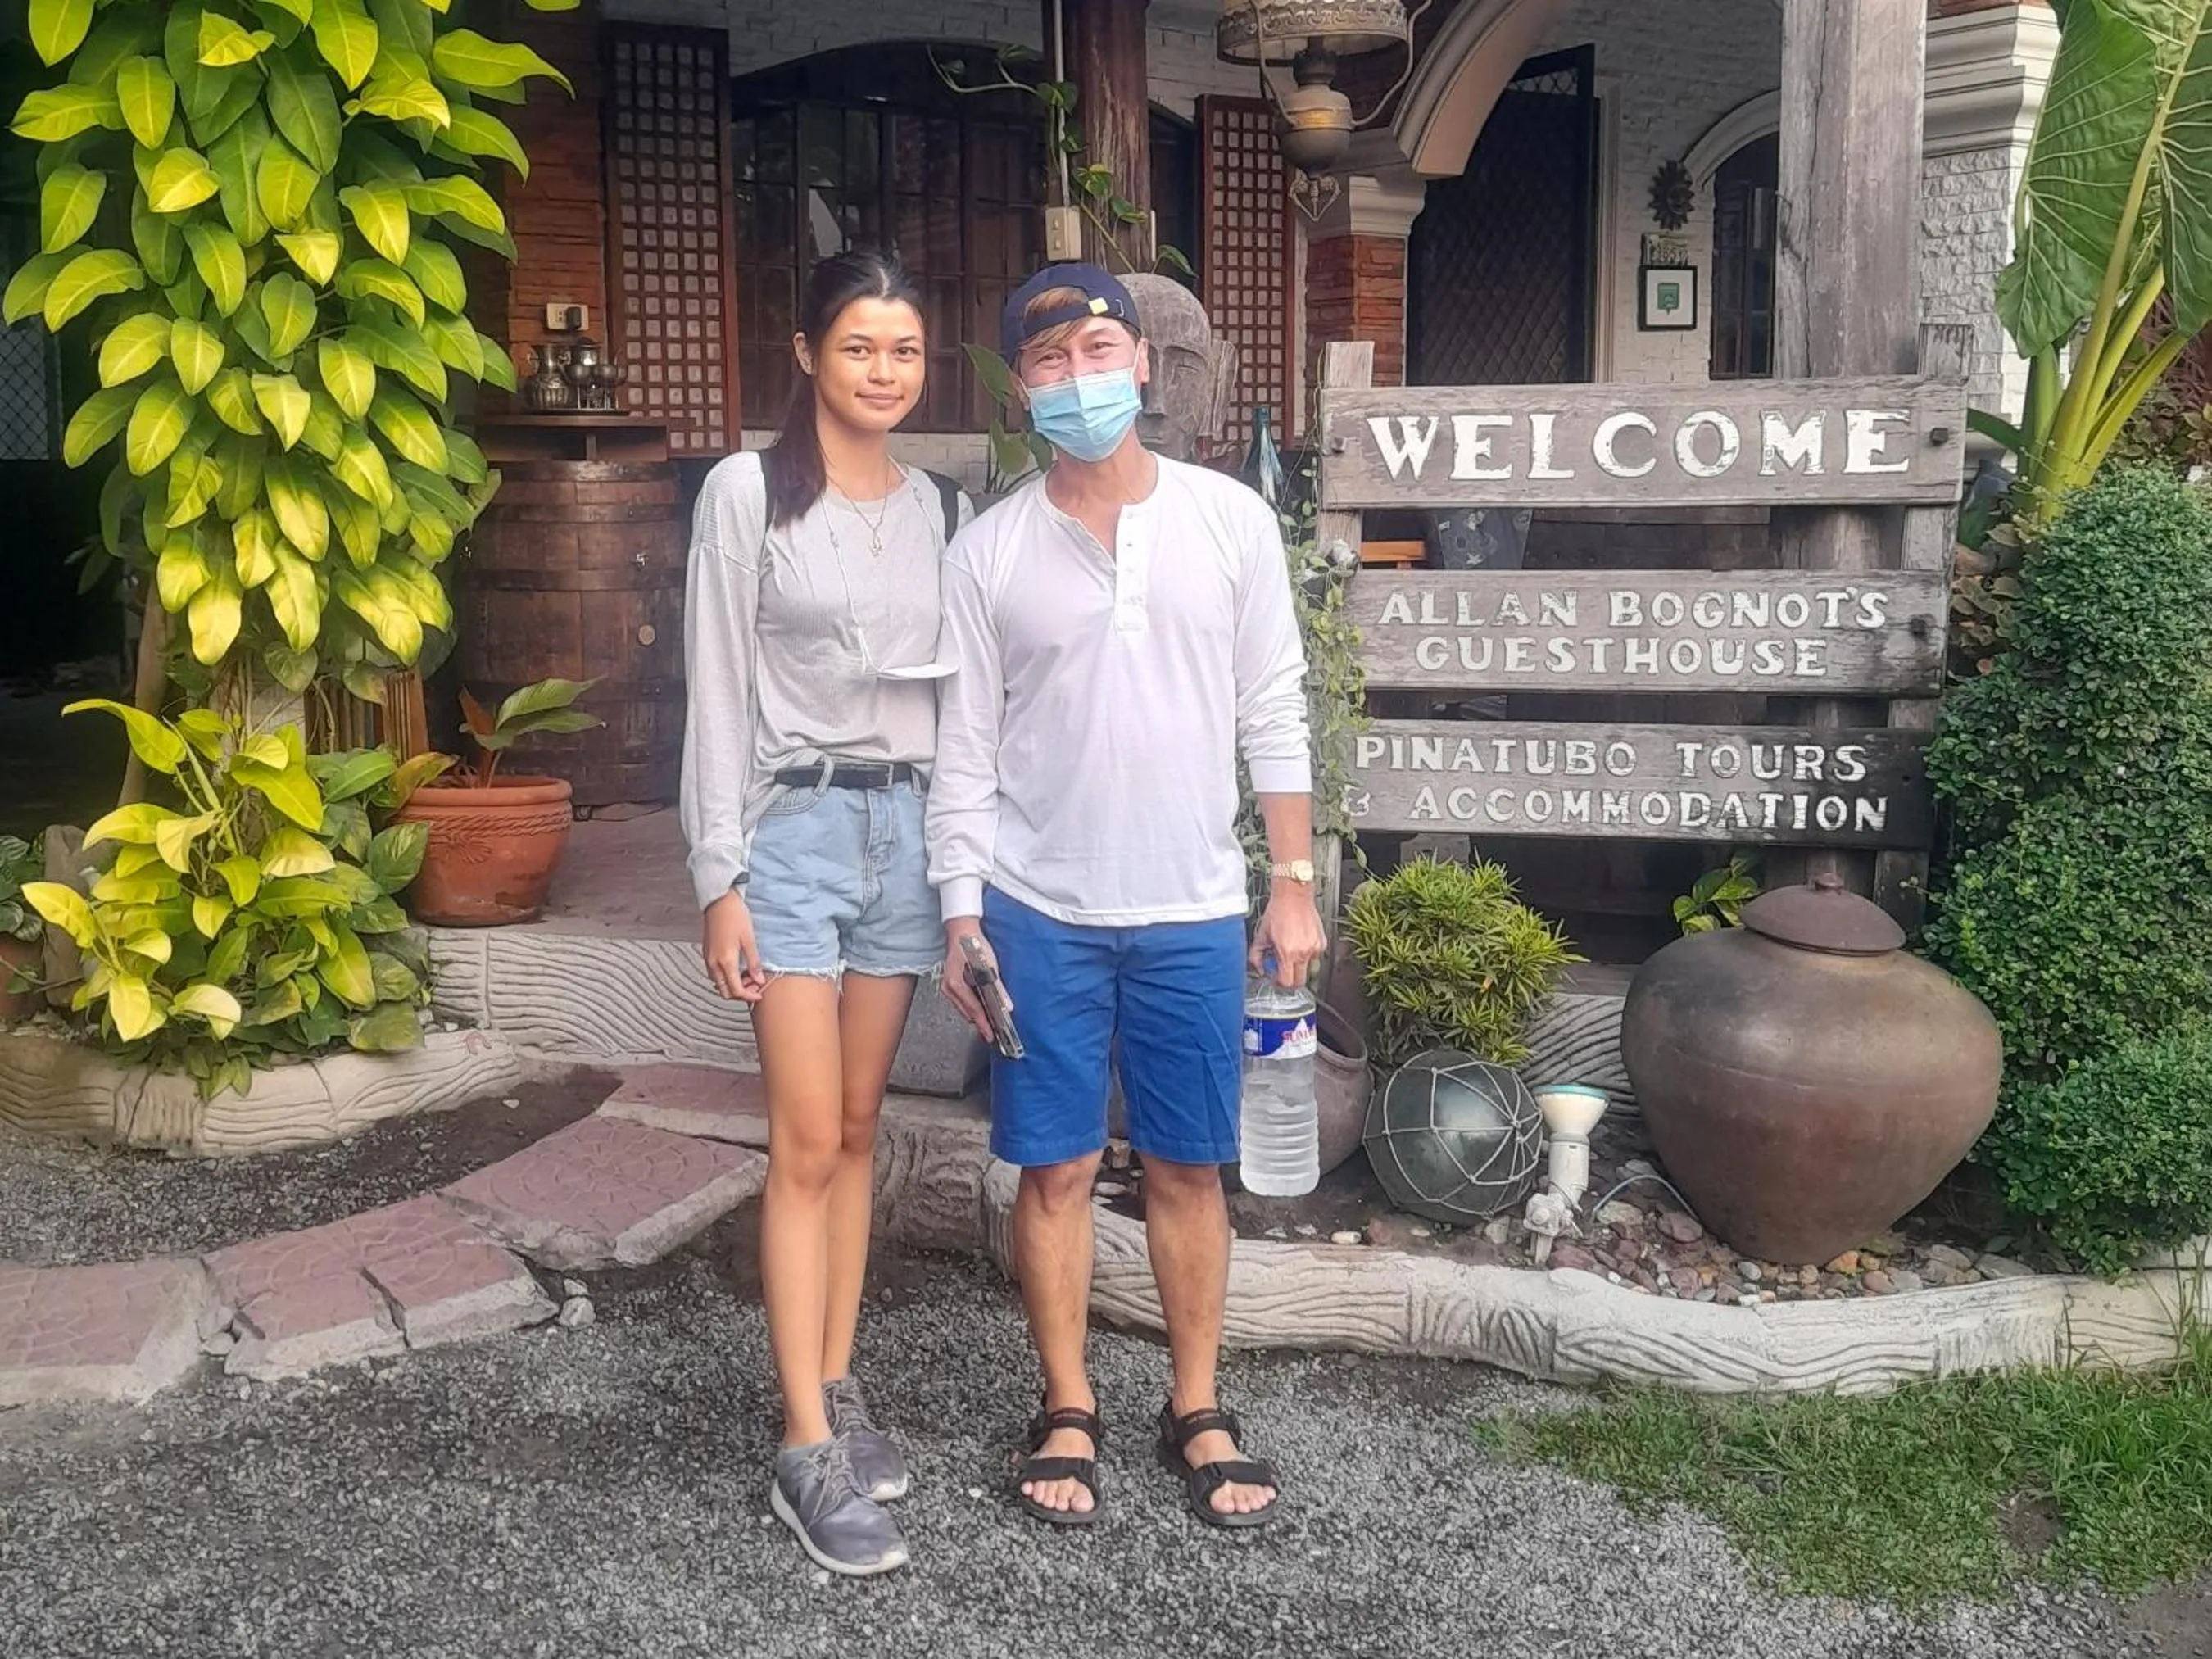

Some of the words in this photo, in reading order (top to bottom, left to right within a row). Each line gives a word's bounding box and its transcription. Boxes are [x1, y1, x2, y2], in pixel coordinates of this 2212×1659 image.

[1367, 410, 1911, 480] WELCOME
[1378, 592, 1578, 628] ALLAN
[1609, 587, 1889, 629] BOGNOT'S
[1416, 636, 1829, 678] GUESTHOUSE
[1355, 736, 1638, 777] PINATUBO
[1676, 741, 1868, 782] TOURS
[1410, 786, 1889, 832] ACCOMMODATION
